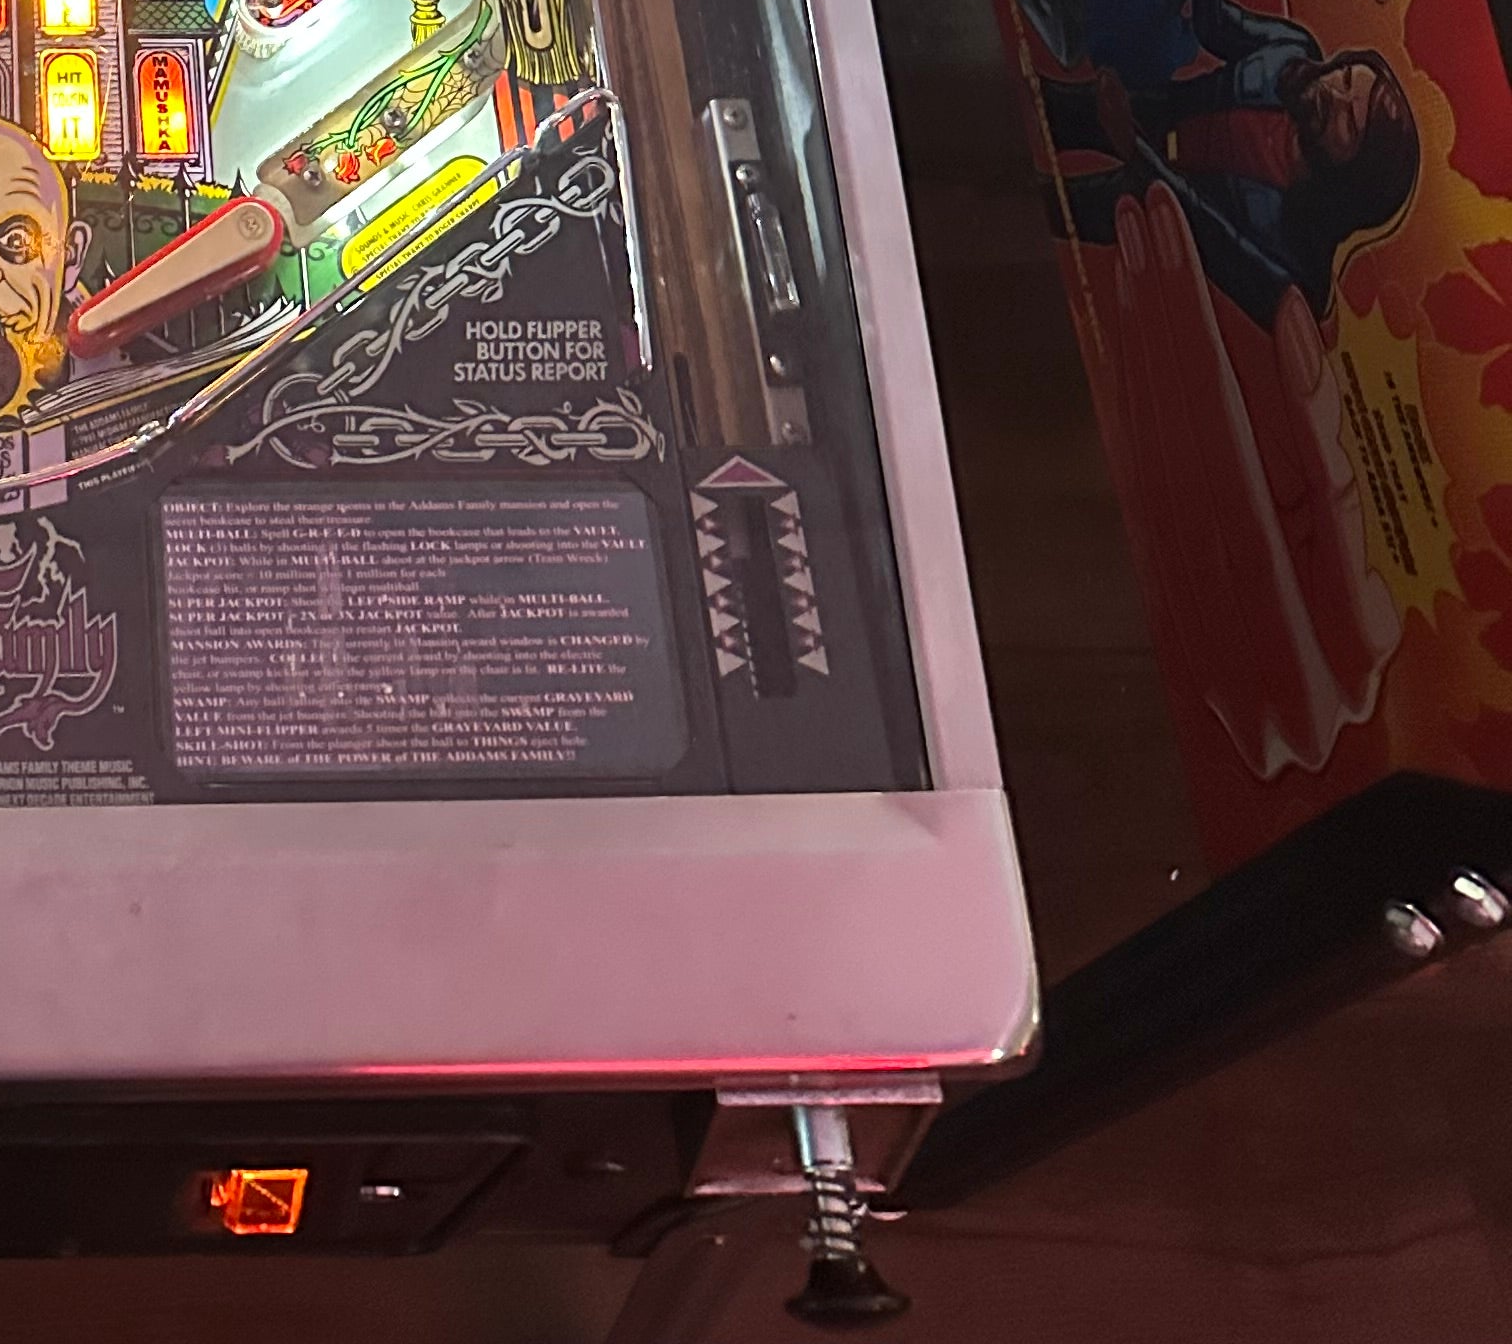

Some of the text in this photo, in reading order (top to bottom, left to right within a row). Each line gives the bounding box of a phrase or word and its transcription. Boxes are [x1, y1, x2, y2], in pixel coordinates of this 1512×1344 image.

[56, 71, 83, 84] HIT
[151, 56, 171, 151] MAMUSHKA
[61, 117, 81, 139] IT
[354, 230, 383, 254] SOUNDS
[390, 214, 410, 229] MUSIC
[465, 320, 603, 340] HOLD FLIPPER
[476, 341, 606, 361] BUTTON FOR
[453, 362, 608, 382] STATUS REPORT
[410, 540, 451, 551] LOCK
[21, 761, 59, 774] FAMILY
[60, 760, 97, 774] THEME
[99, 760, 134, 773] MUSIC
[25, 777, 60, 790] MUSIC
